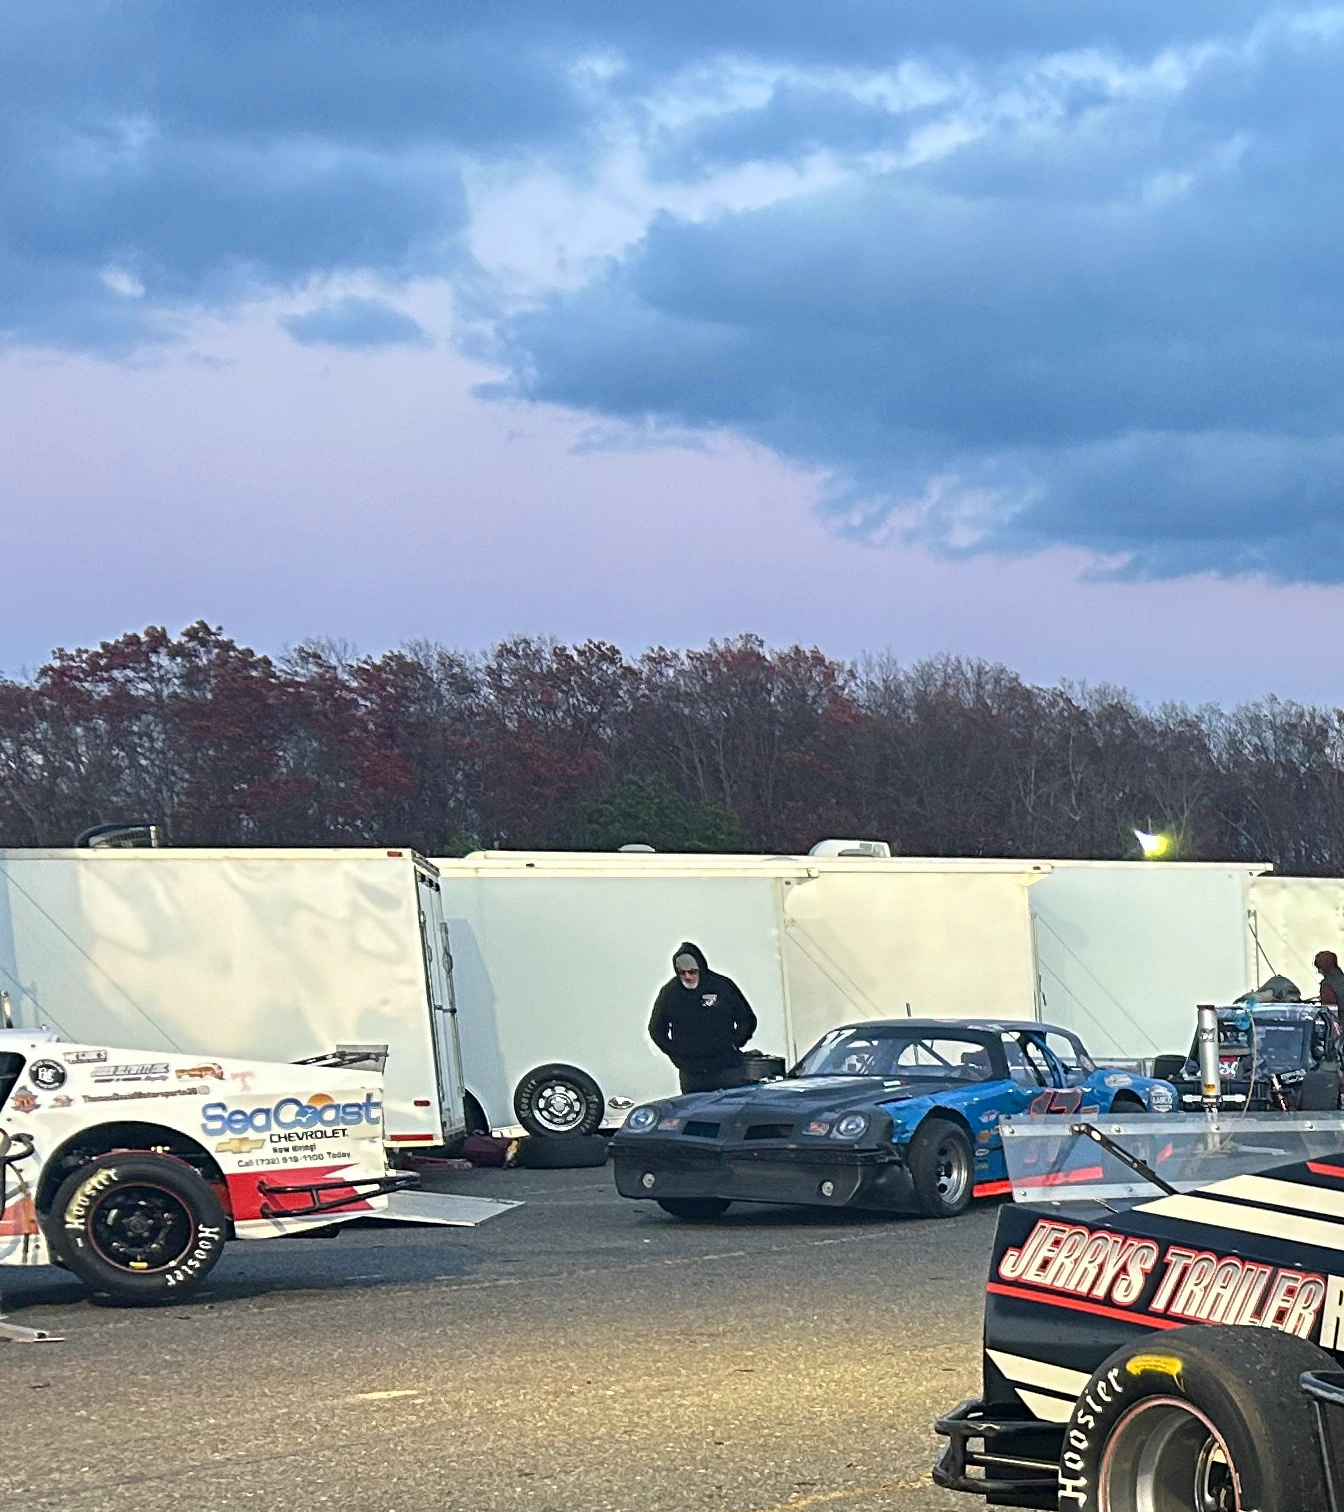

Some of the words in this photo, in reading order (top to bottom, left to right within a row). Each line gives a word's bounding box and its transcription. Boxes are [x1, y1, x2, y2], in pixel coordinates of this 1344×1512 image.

[269, 1128, 349, 1144] CHEVROLET
[998, 1217, 1160, 1307] JERRYS
[1148, 1243, 1327, 1341] TRAILER
[1057, 1366, 1125, 1508] Hoosier
